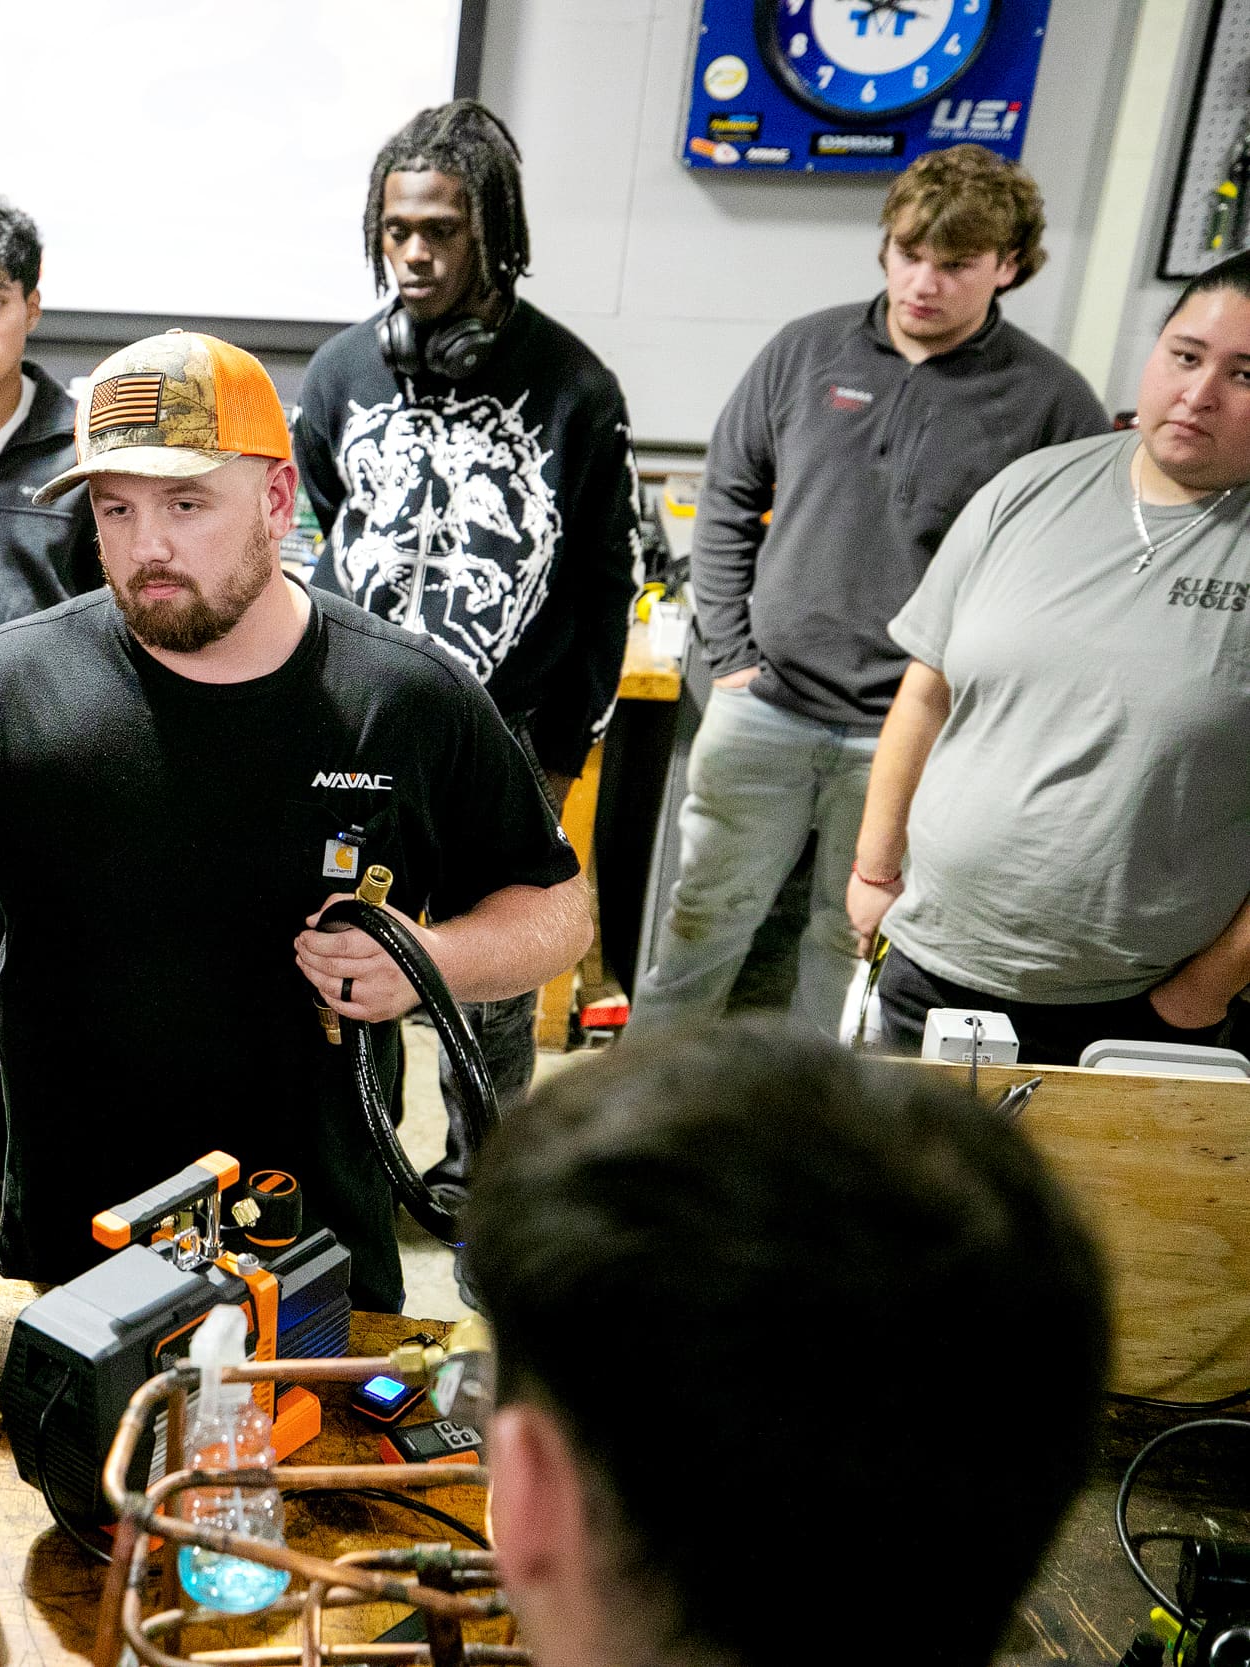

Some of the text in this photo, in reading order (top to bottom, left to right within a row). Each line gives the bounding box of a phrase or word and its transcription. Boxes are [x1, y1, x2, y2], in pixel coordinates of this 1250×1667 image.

[789, 32, 809, 58] 8
[943, 32, 962, 57] 4
[816, 65, 836, 89] 7
[911, 65, 930, 89] 5
[860, 80, 877, 103] 6
[1171, 576, 1250, 598] KLEIN
[1168, 591, 1247, 612] TOOLS
[310, 770, 394, 791] NAVAC
